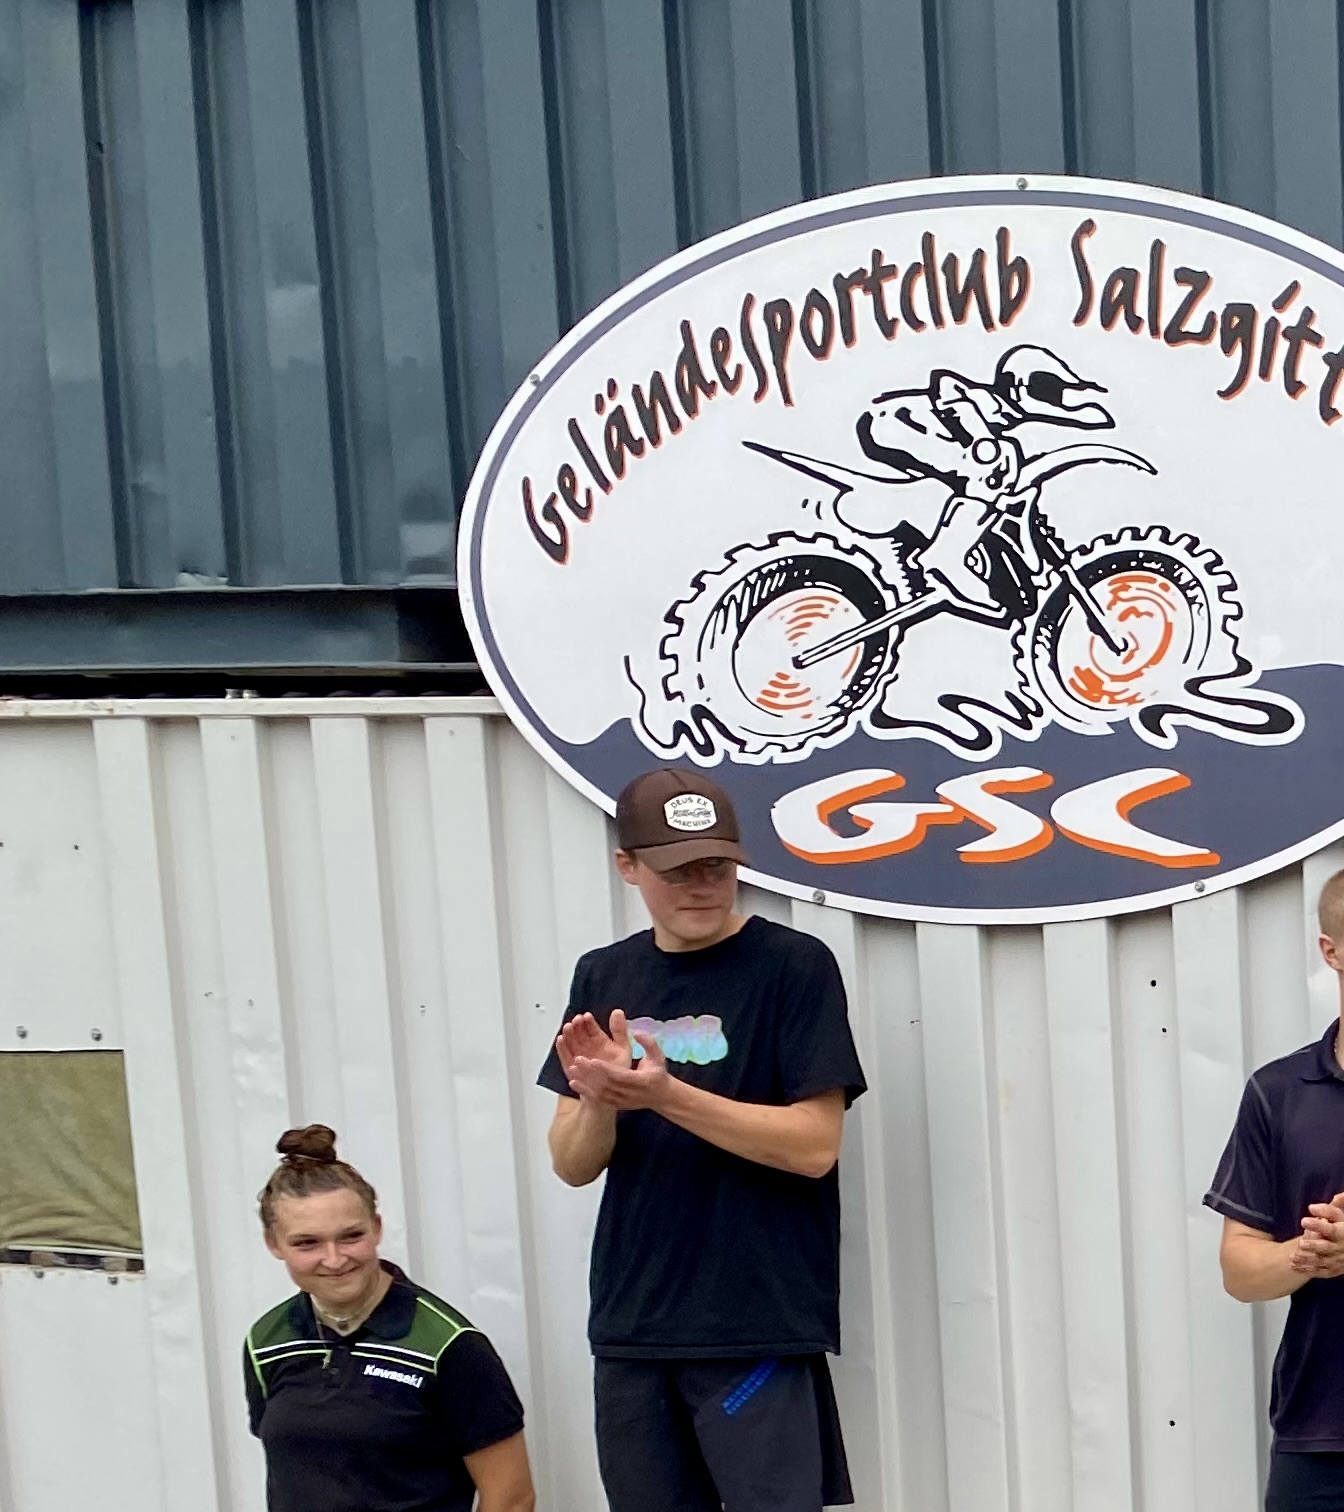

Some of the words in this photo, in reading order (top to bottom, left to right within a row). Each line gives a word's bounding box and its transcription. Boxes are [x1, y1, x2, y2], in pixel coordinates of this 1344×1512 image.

[519, 226, 1031, 566] Geländesportclub
[670, 796, 694, 808] DEUS
[771, 766, 1221, 865] GSC
[362, 1363, 424, 1389] Kawasaki
